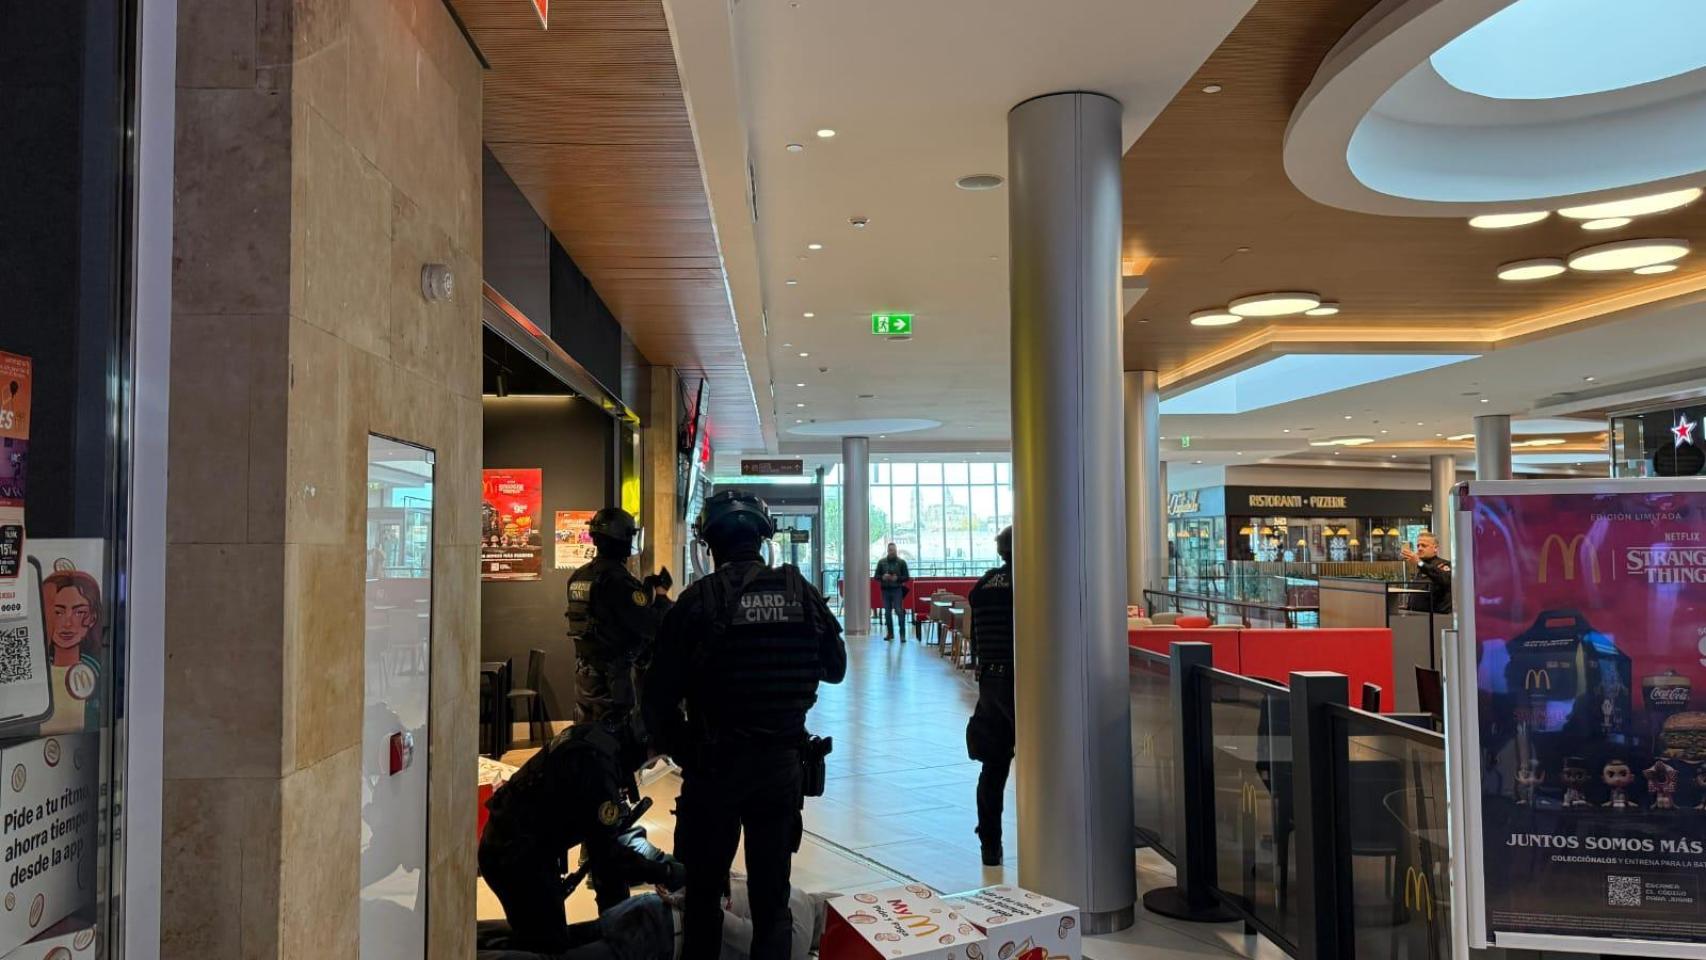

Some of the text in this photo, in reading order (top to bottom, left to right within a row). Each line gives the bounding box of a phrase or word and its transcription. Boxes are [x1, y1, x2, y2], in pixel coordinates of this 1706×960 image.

[1249, 495, 1347, 508] RISTORANTI PIZZERIE
[1635, 512, 1681, 521] LIMITADA
[1665, 532, 1700, 541] NETFLIX
[740, 593, 802, 608] UARDA
[746, 608, 789, 622] CIVIL
[4, 806, 33, 834] Pide
[36, 805, 43, 820] a
[46, 798, 58, 816] tu
[5, 830, 48, 862] ahorra
[1506, 833, 1703, 854] JUNTOS SOMOS MÁS
[10, 838, 83, 888] desde la app
[1551, 854, 1617, 864] COLECCIÓNALOS
[1625, 858, 1659, 866] ENTRENA
